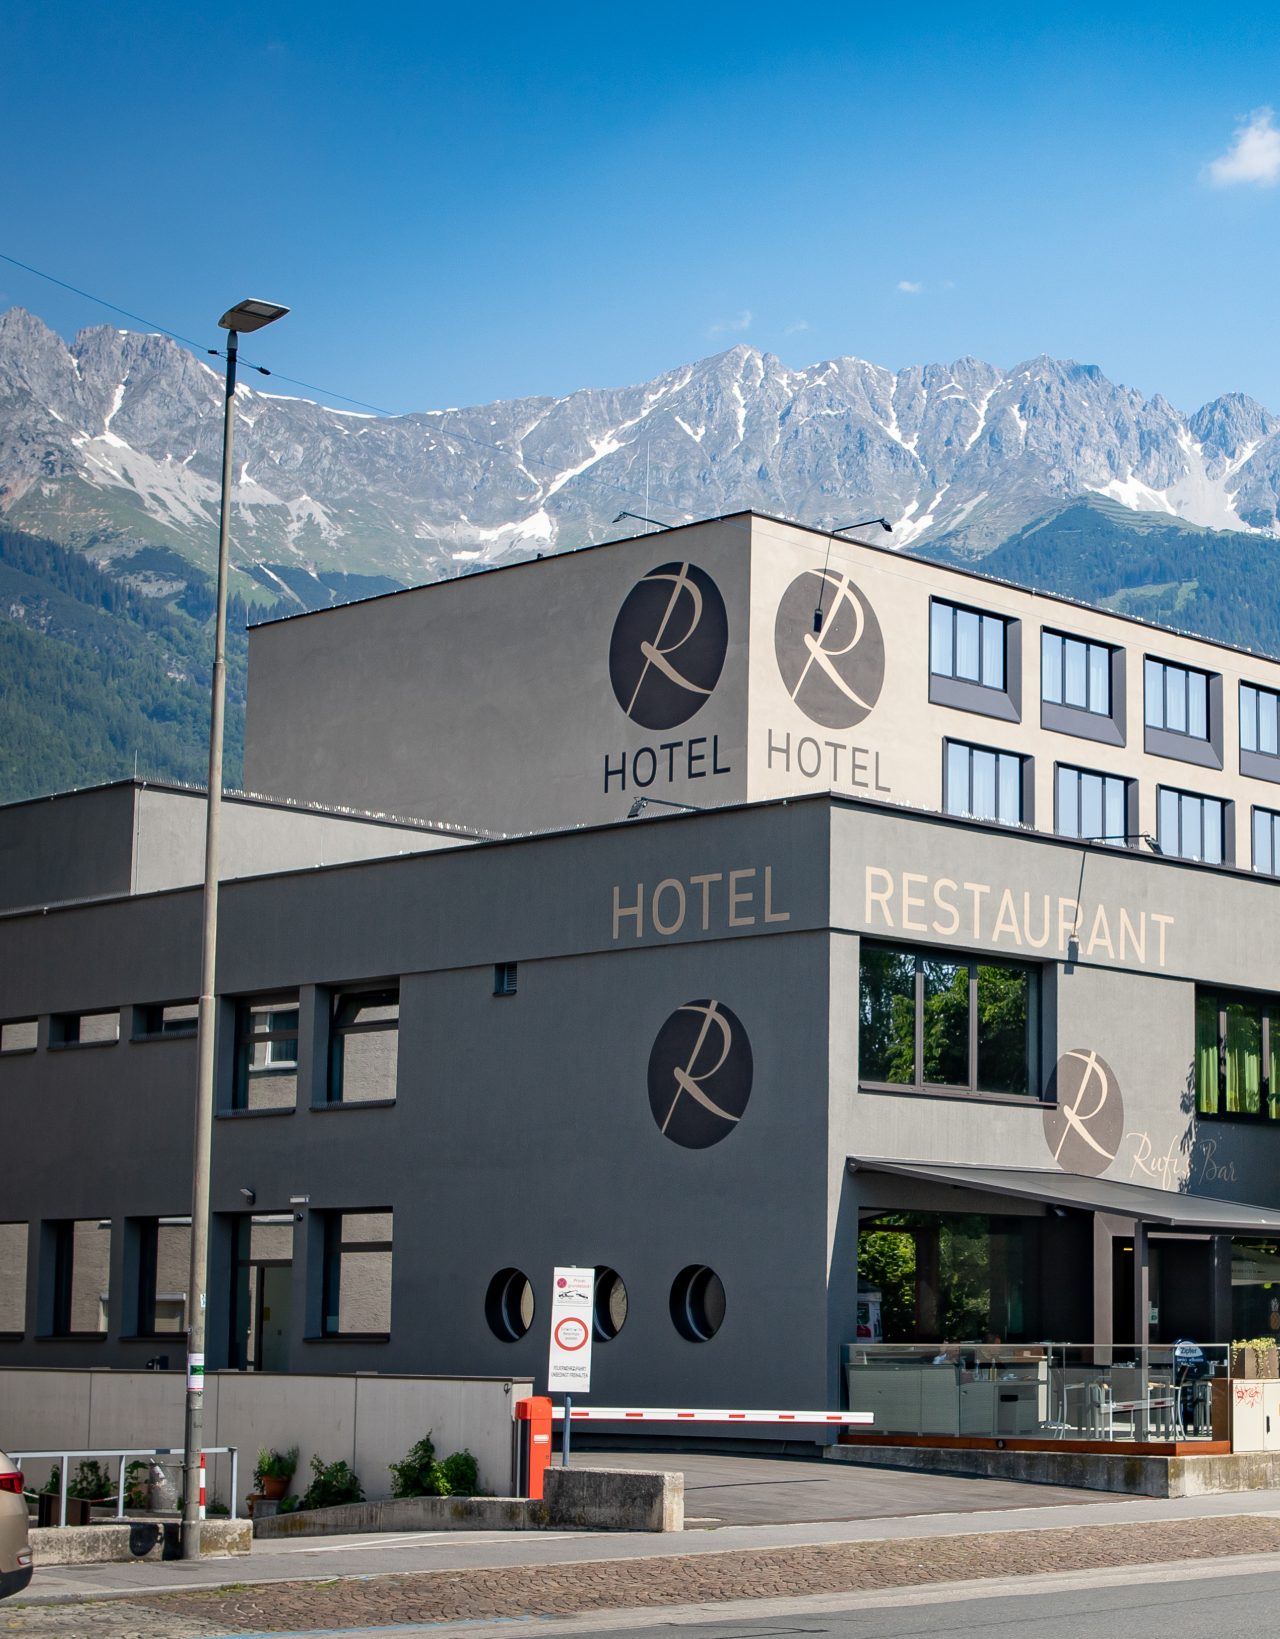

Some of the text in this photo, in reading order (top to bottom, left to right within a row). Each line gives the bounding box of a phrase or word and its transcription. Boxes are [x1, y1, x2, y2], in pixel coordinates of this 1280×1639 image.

[604, 735, 731, 794] HOTEL
[767, 728, 891, 793] HOTEL
[612, 865, 790, 940] HOTEL
[864, 865, 1175, 967] RESTAURANT
[1198, 1138, 1238, 1186] Bar
